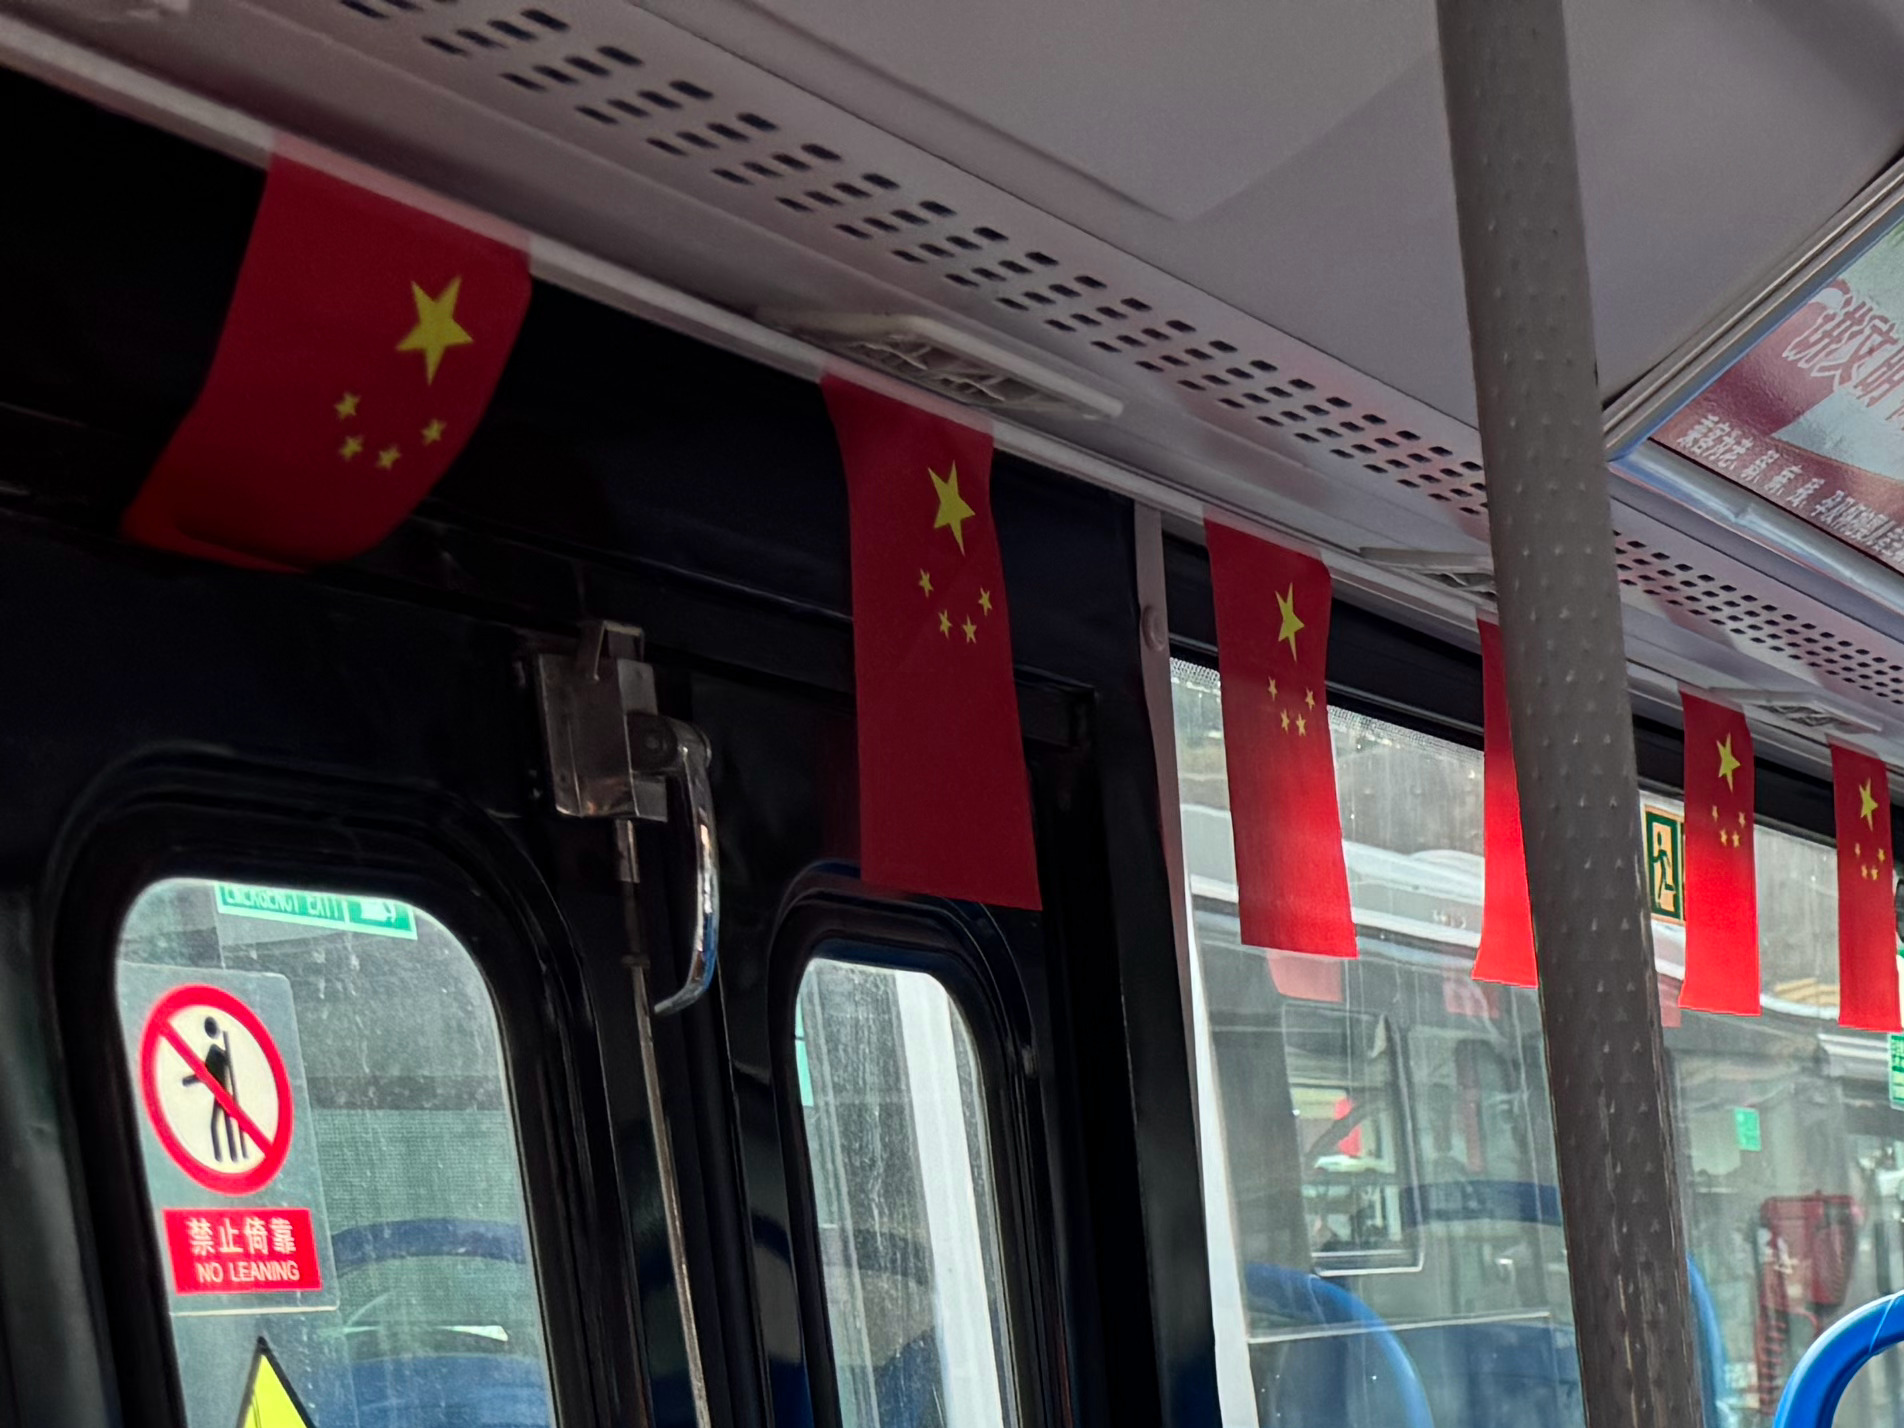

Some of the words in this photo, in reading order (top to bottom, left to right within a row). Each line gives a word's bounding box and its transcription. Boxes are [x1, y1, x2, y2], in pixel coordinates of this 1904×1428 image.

[186, 1217, 296, 1256] 禁止倚靠
[195, 1261, 224, 1282] NO
[230, 1260, 300, 1282] LEANING
